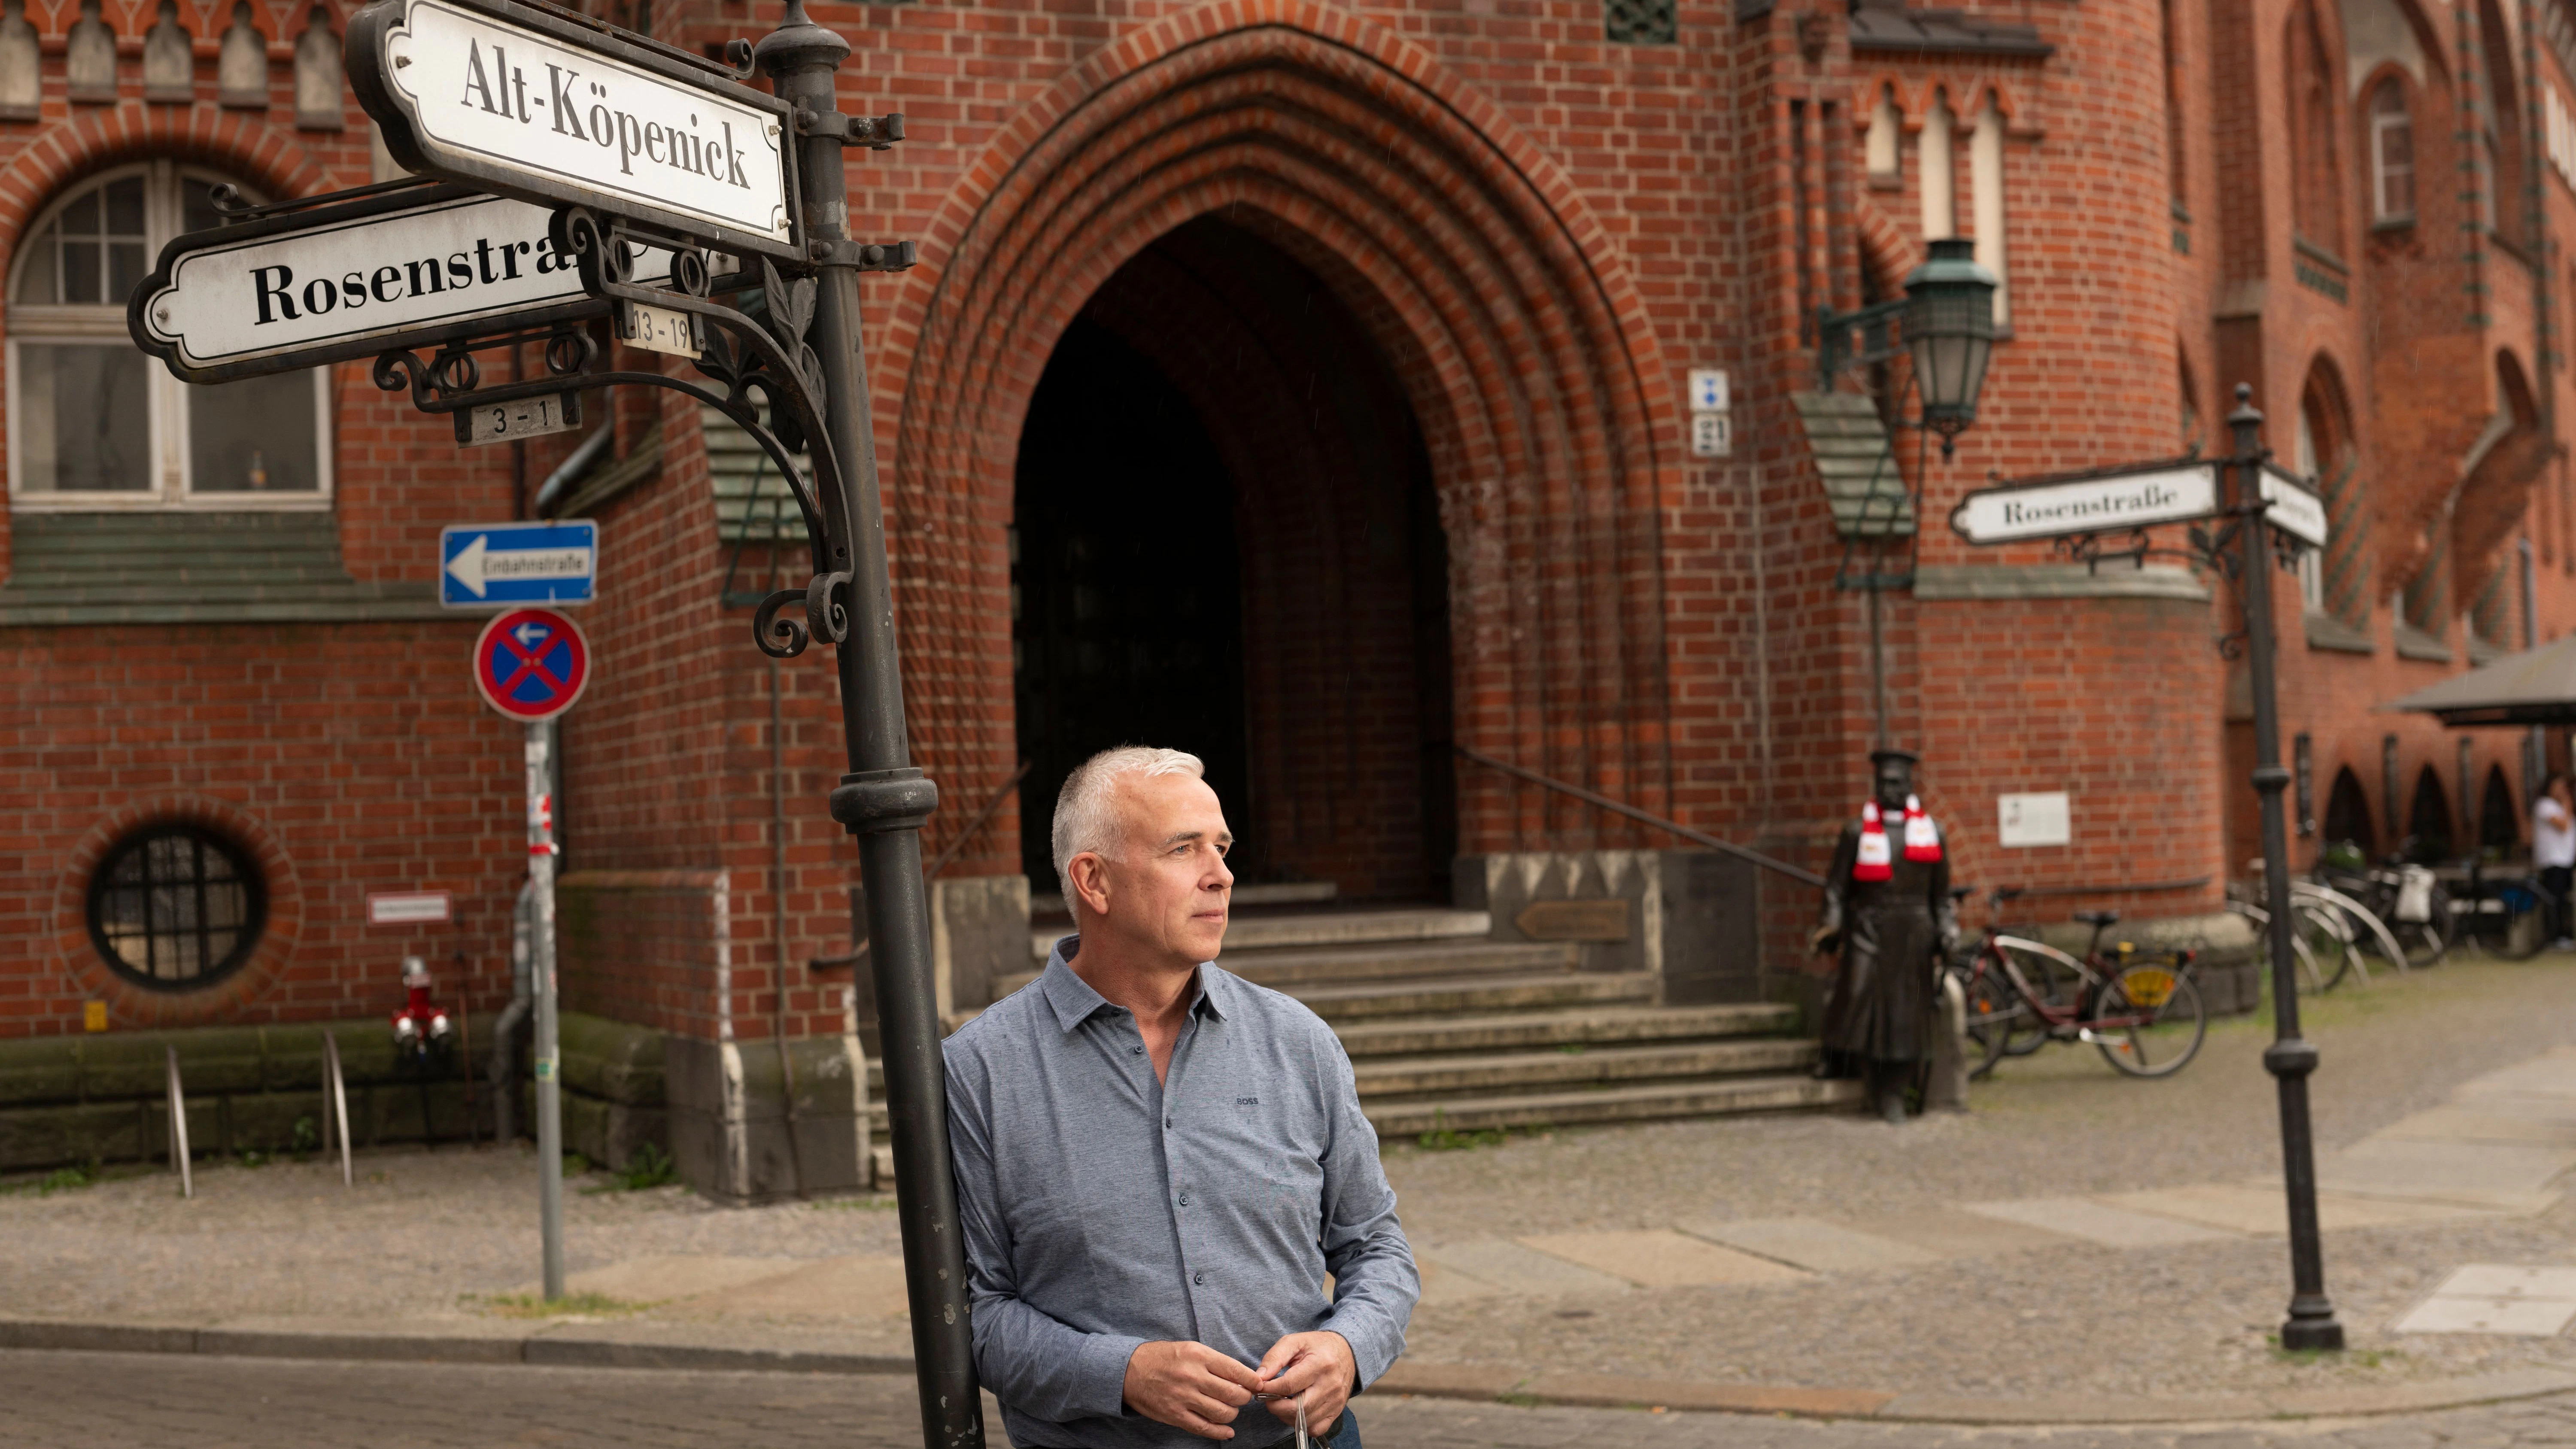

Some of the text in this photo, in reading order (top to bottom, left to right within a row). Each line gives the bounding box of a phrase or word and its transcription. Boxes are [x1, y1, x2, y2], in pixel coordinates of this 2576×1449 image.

[461, 37, 750, 190] Alt-Köpenick
[249, 237, 648, 325] Rosenstra
[634, 310, 653, 341] 13
[670, 318, 687, 349] 19
[492, 408, 507, 433] 3
[539, 400, 547, 426] 1
[2003, 483, 2178, 526] Rosenstraße
[481, 553, 583, 575] Einbahnstraße
[1236, 1097, 1259, 1105] BOSS
